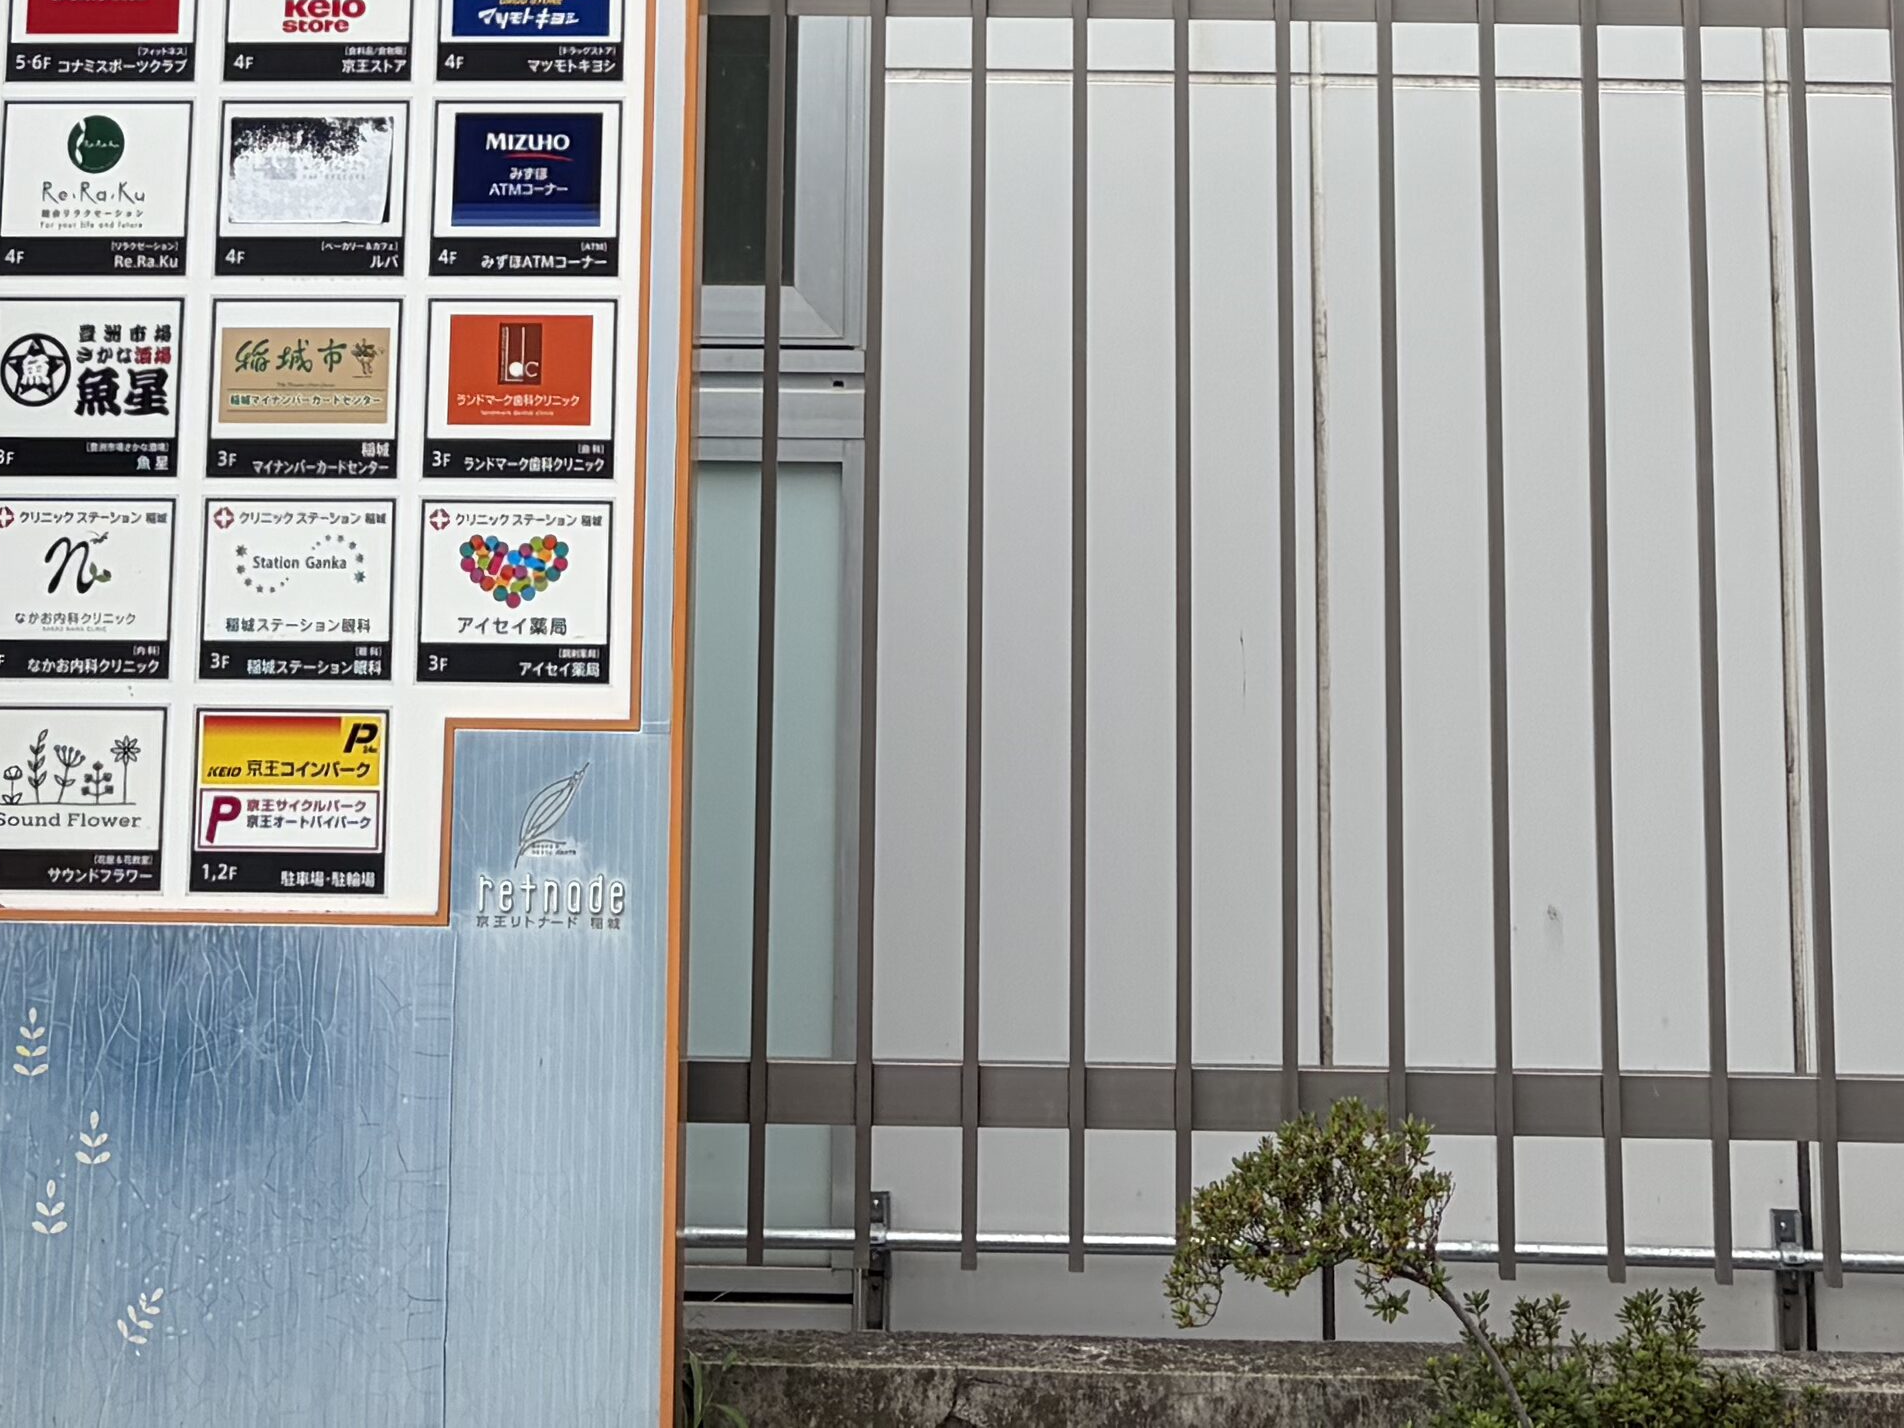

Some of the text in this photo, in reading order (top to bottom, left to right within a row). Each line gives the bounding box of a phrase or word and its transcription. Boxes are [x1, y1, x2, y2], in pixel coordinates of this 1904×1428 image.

[281, 19, 350, 34] store
[57, 57, 187, 75] コナミスポーツクラブ
[232, 55, 407, 74] 4F 京王ストア
[444, 55, 617, 74] 4F マツモトキヨシ
[485, 132, 571, 151] MIZUHO
[509, 167, 549, 181] みずほ
[489, 182, 569, 196] ATMコーナー
[3, 248, 25, 265] 4F
[224, 248, 246, 265] 4F
[437, 249, 608, 270] 4F みずほATMコーナー
[76, 346, 172, 365] さかな酒場
[234, 338, 347, 374] 稲城市
[74, 366, 170, 417] 魚星
[456, 393, 580, 408] ランドマーク歯科クリニック
[361, 441, 390, 458] 稲城
[217, 450, 389, 476] 3F マイナンバーカードセンター
[431, 450, 605, 472] 3F ランドマーク歯科クリニック
[252, 555, 347, 570] Station Ganka
[14, 612, 137, 625] なかお内科クリニック
[225, 617, 371, 634] 稲城ステーション眼科
[457, 617, 568, 636] アイセイ薬局
[27, 658, 160, 674] なかお内科クリニック
[209, 652, 382, 676] 3F 稲城ステーション眼科
[428, 655, 600, 678] 3F アイセイ薬局
[343, 723, 379, 754] P
[206, 759, 371, 778] KEIO 京王コインパーク
[246, 799, 367, 813] 京王サイクルパーク
[67, 813, 143, 828] Flower
[205, 795, 242, 844] P
[246, 815, 372, 829] 京王オートバイパーク
[47, 867, 153, 884] サウンドフラワー
[201, 863, 238, 881] 1,2F
[476, 915, 578, 930] 京王リトナード
